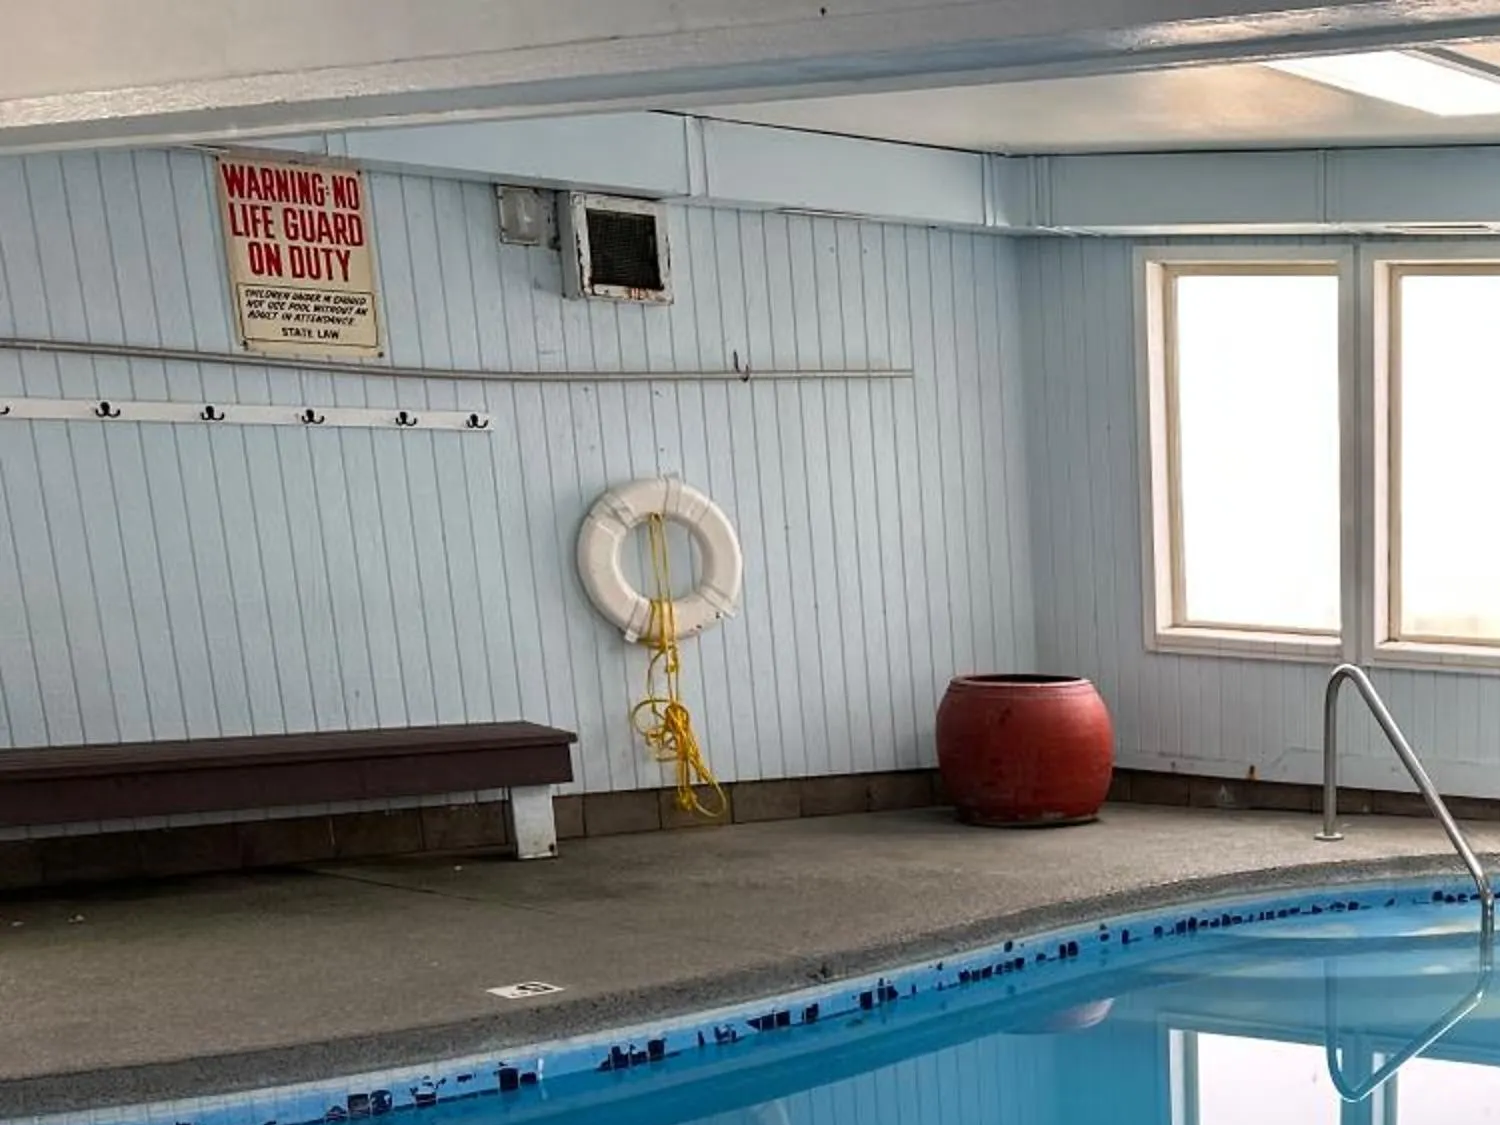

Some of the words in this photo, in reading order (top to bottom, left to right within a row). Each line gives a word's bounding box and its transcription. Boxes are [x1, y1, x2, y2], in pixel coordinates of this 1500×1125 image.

[222, 163, 330, 207] WARNING:
[332, 176, 360, 210] NO
[229, 203, 274, 239] LIFE
[283, 208, 363, 246] GUARD
[248, 242, 282, 277] ON
[288, 246, 351, 282] DUTY
[281, 327, 312, 338] STATE
[317, 330, 339, 339] LAW
